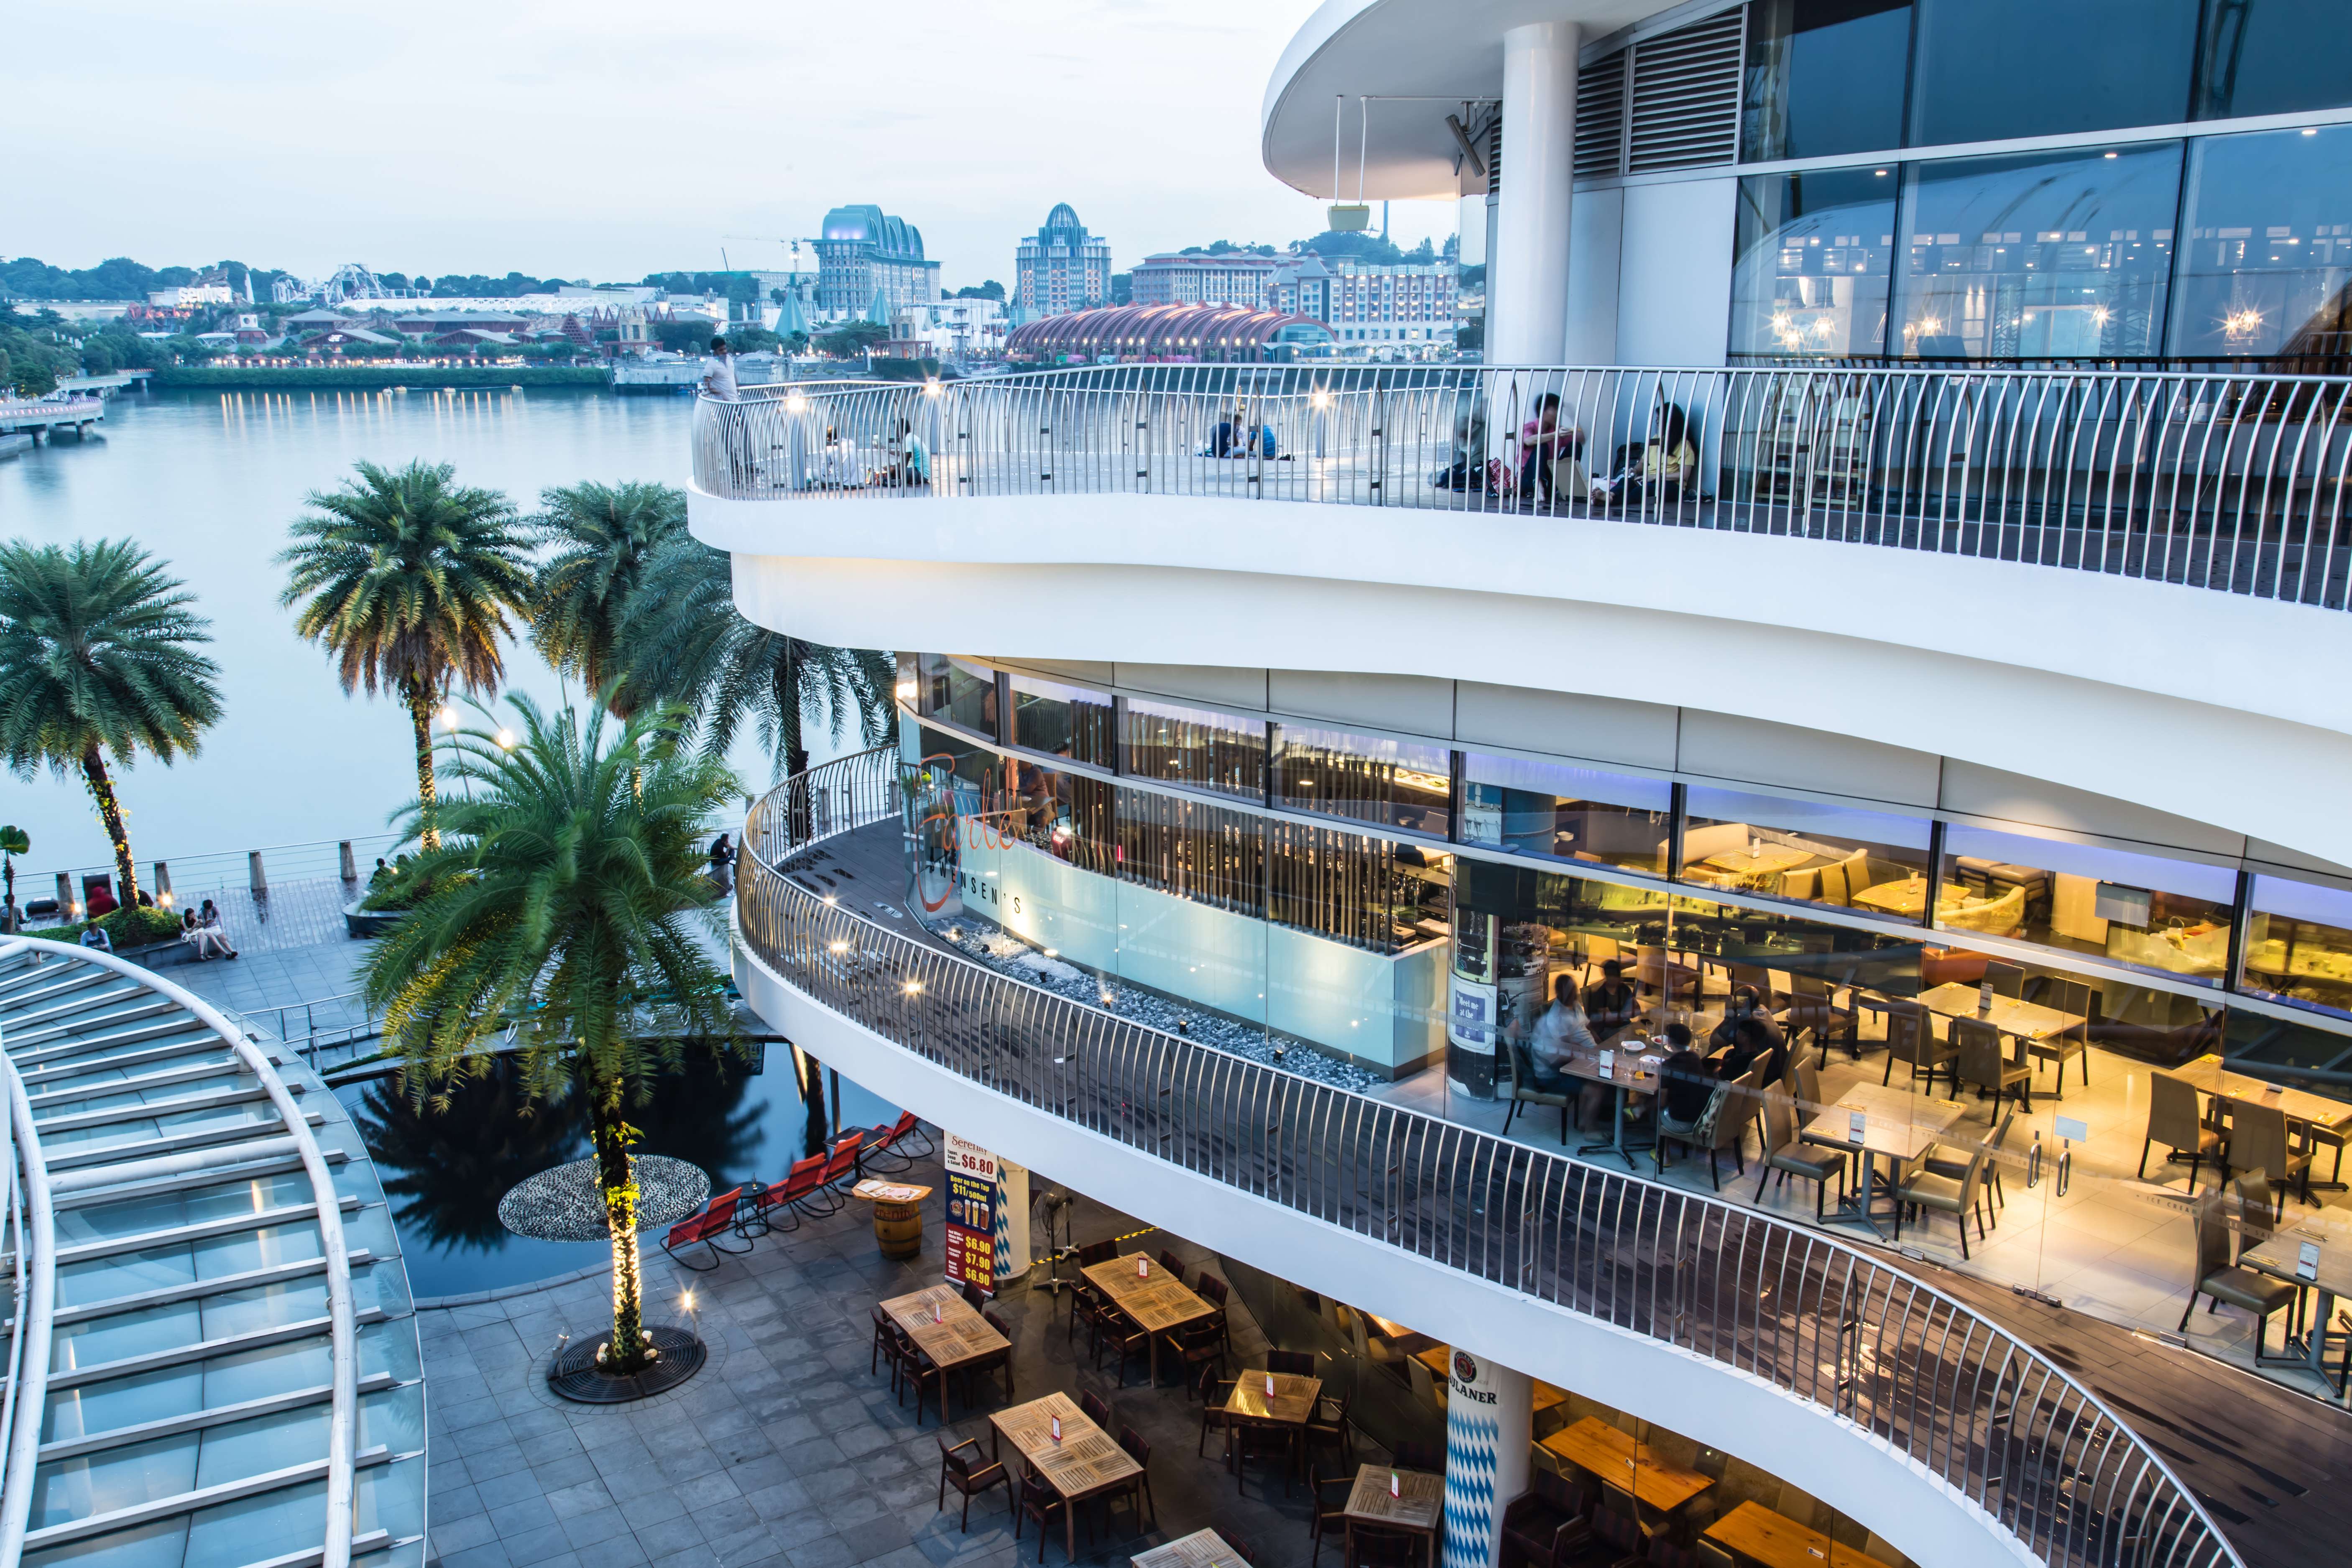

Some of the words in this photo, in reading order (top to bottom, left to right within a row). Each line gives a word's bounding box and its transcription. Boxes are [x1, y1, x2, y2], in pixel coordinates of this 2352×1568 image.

[179, 283, 233, 304] sentosa
[914, 753, 1020, 912] Earle
[962, 1153, 993, 1175] $6.80
[950, 1175, 963, 1183] Beer
[981, 1183, 989, 1192] Tap
[953, 1182, 986, 1203] $11/500ml
[2147, 1196, 2160, 1204] ICE
[965, 1236, 991, 1254] $6.90
[965, 1251, 990, 1270] $7.90
[965, 1267, 990, 1286] $6.90
